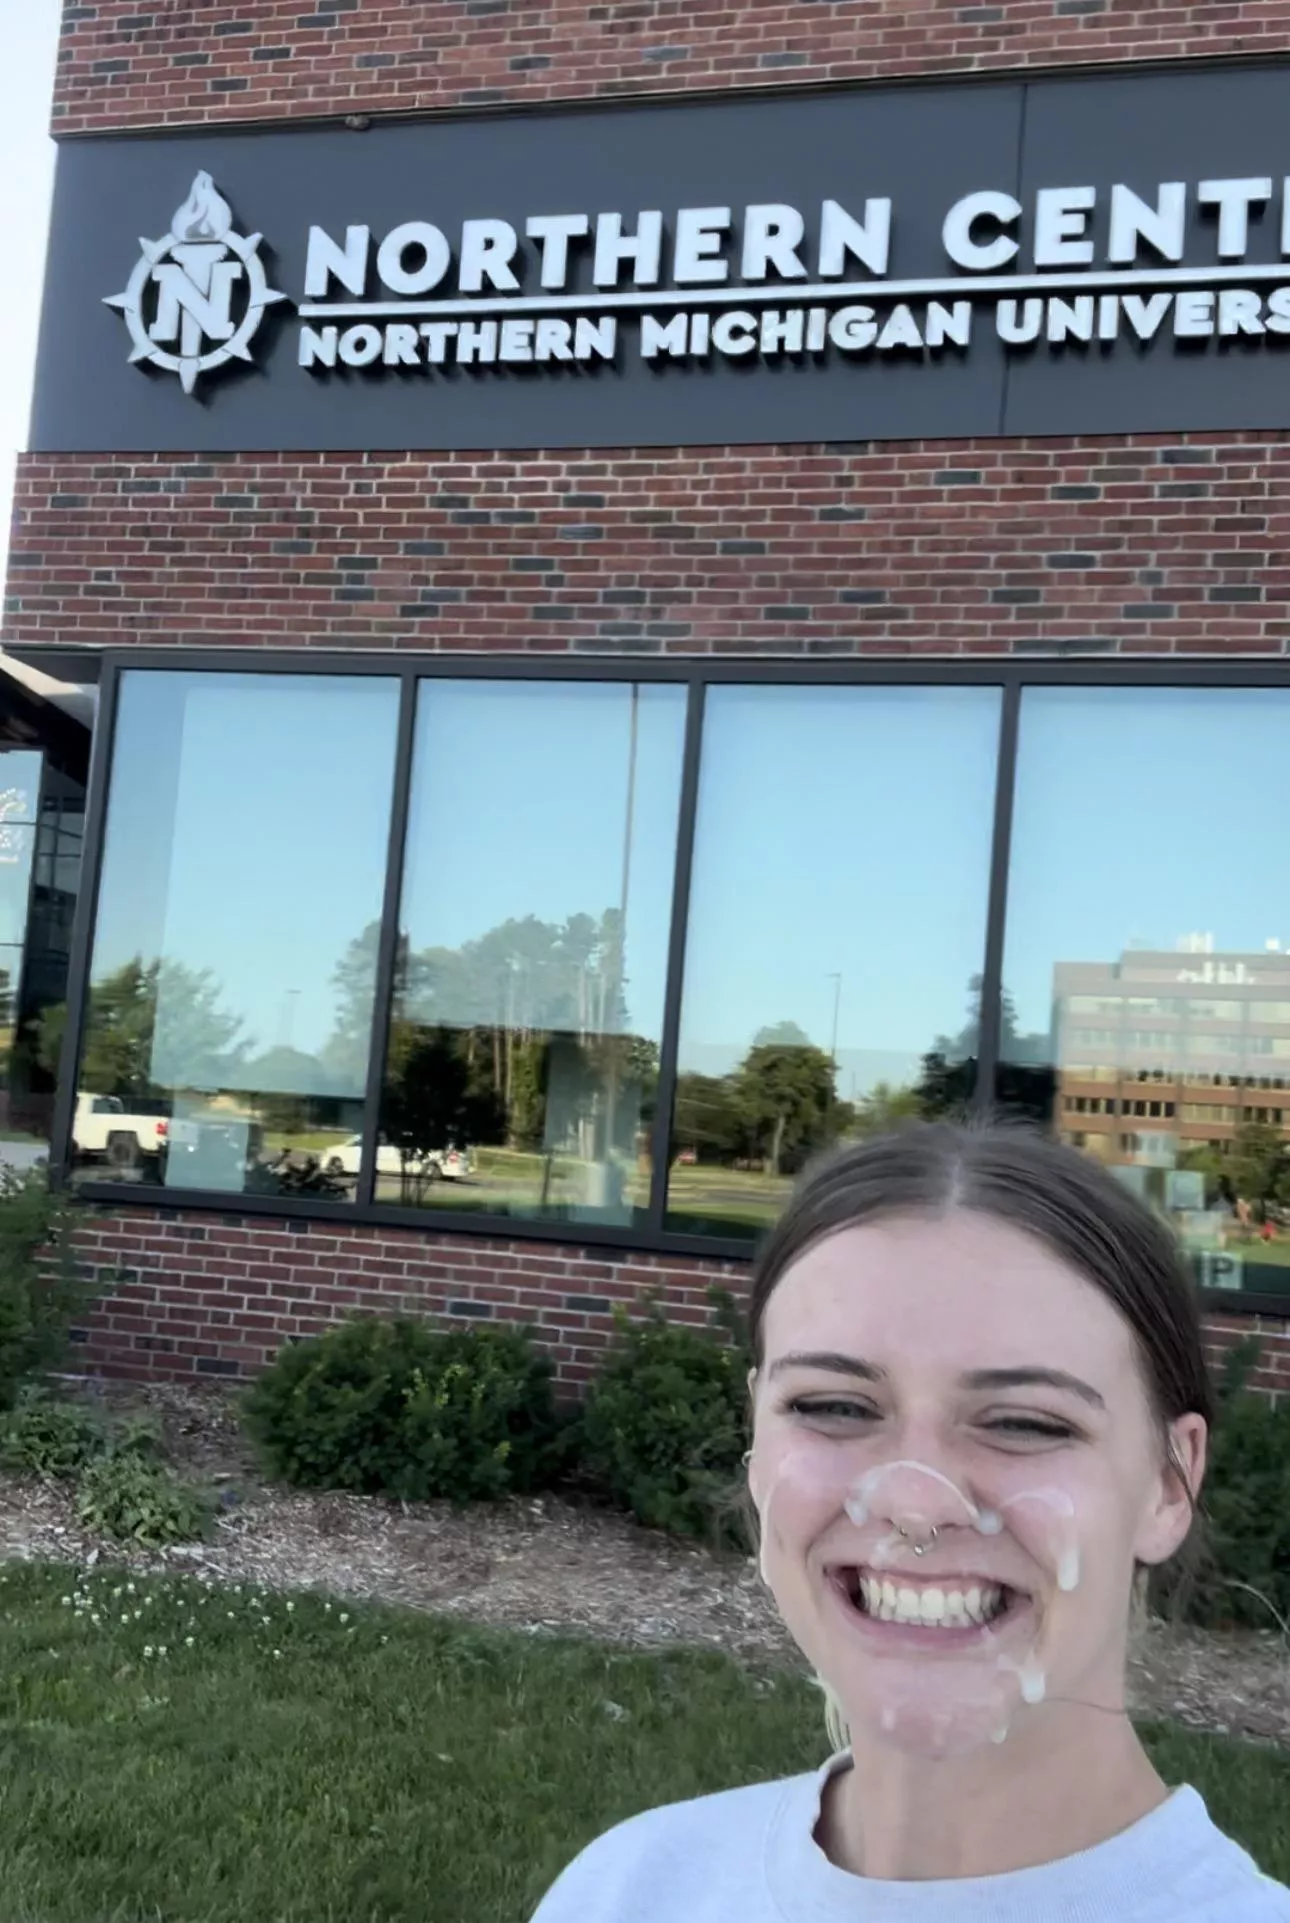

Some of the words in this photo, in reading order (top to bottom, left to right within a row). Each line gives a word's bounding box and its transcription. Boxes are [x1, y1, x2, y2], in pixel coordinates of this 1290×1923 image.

[303, 197, 891, 297] NORTHERN
[149, 261, 242, 341] N
[299, 316, 615, 367] NORTHERN
[641, 301, 971, 358] MICHIGAN
